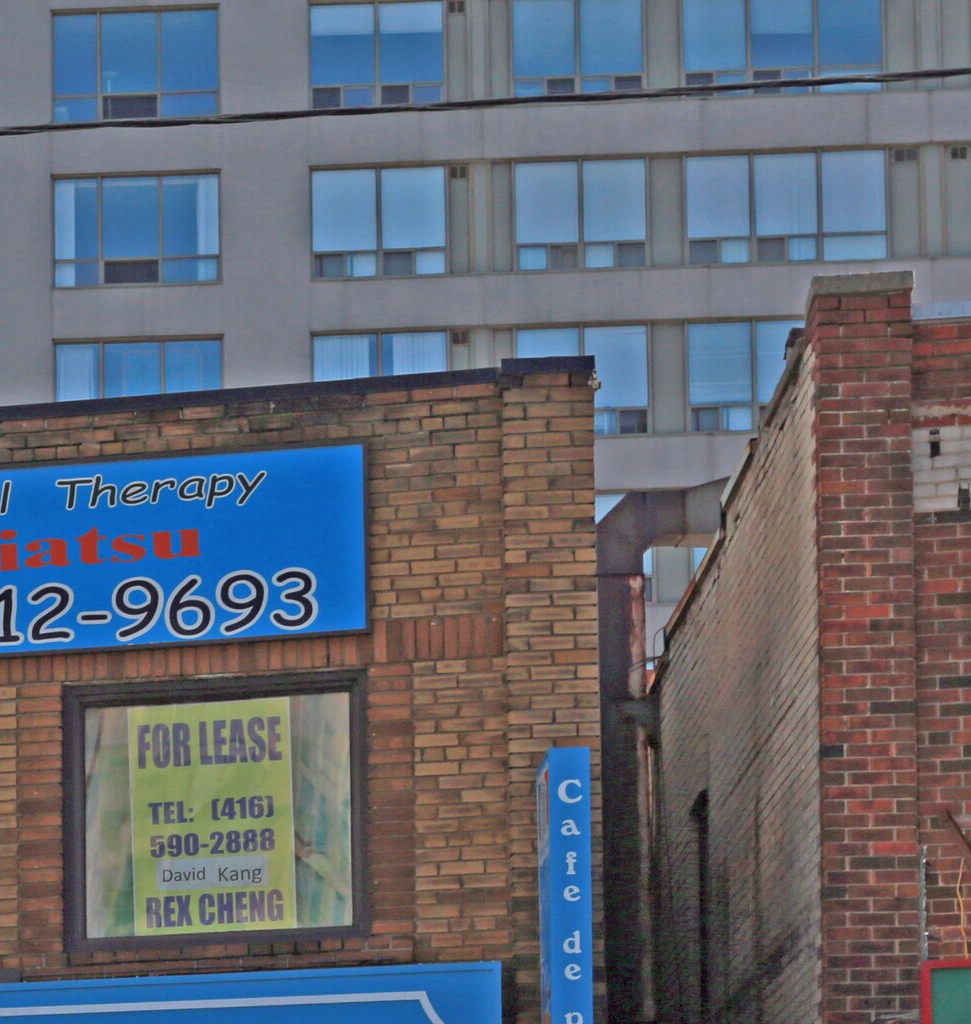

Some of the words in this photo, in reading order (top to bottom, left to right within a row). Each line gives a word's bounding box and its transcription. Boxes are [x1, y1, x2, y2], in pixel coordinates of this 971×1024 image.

[55, 470, 267, 510] Therapy
[137, 722, 191, 769] FOR
[199, 716, 283, 765] LEASE
[148, 801, 194, 824] TEL:
[211, 795, 274, 821] (416)
[150, 828, 275, 858] 590-2888
[557, 779, 583, 902] Cafe
[162, 867, 206, 882] David
[218, 867, 262, 883] Kang
[146, 895, 193, 928] REX
[199, 889, 284, 925] CHENG
[562, 930, 583, 981] de
